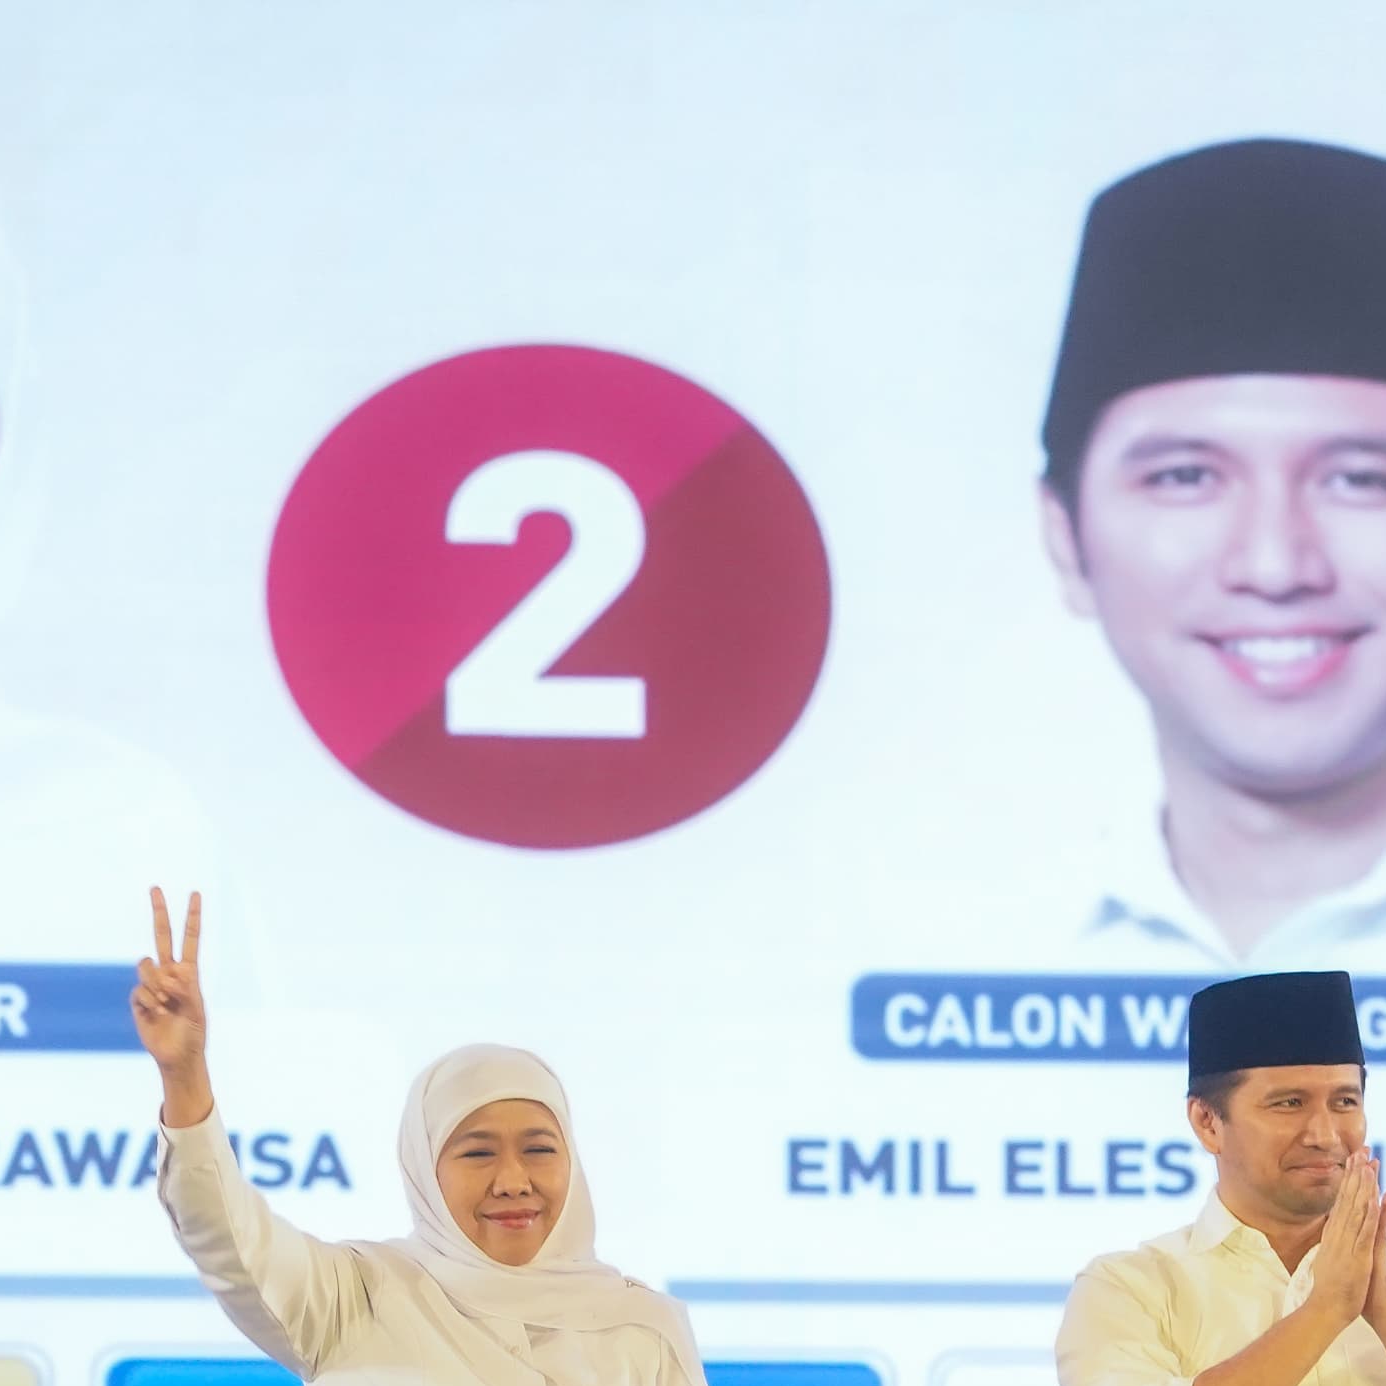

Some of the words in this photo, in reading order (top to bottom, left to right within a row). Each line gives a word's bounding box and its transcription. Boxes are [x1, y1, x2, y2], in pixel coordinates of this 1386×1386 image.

[445, 450, 646, 738] 2
[885, 993, 1105, 1047] CALON
[788, 1139, 975, 1195] EMIL
